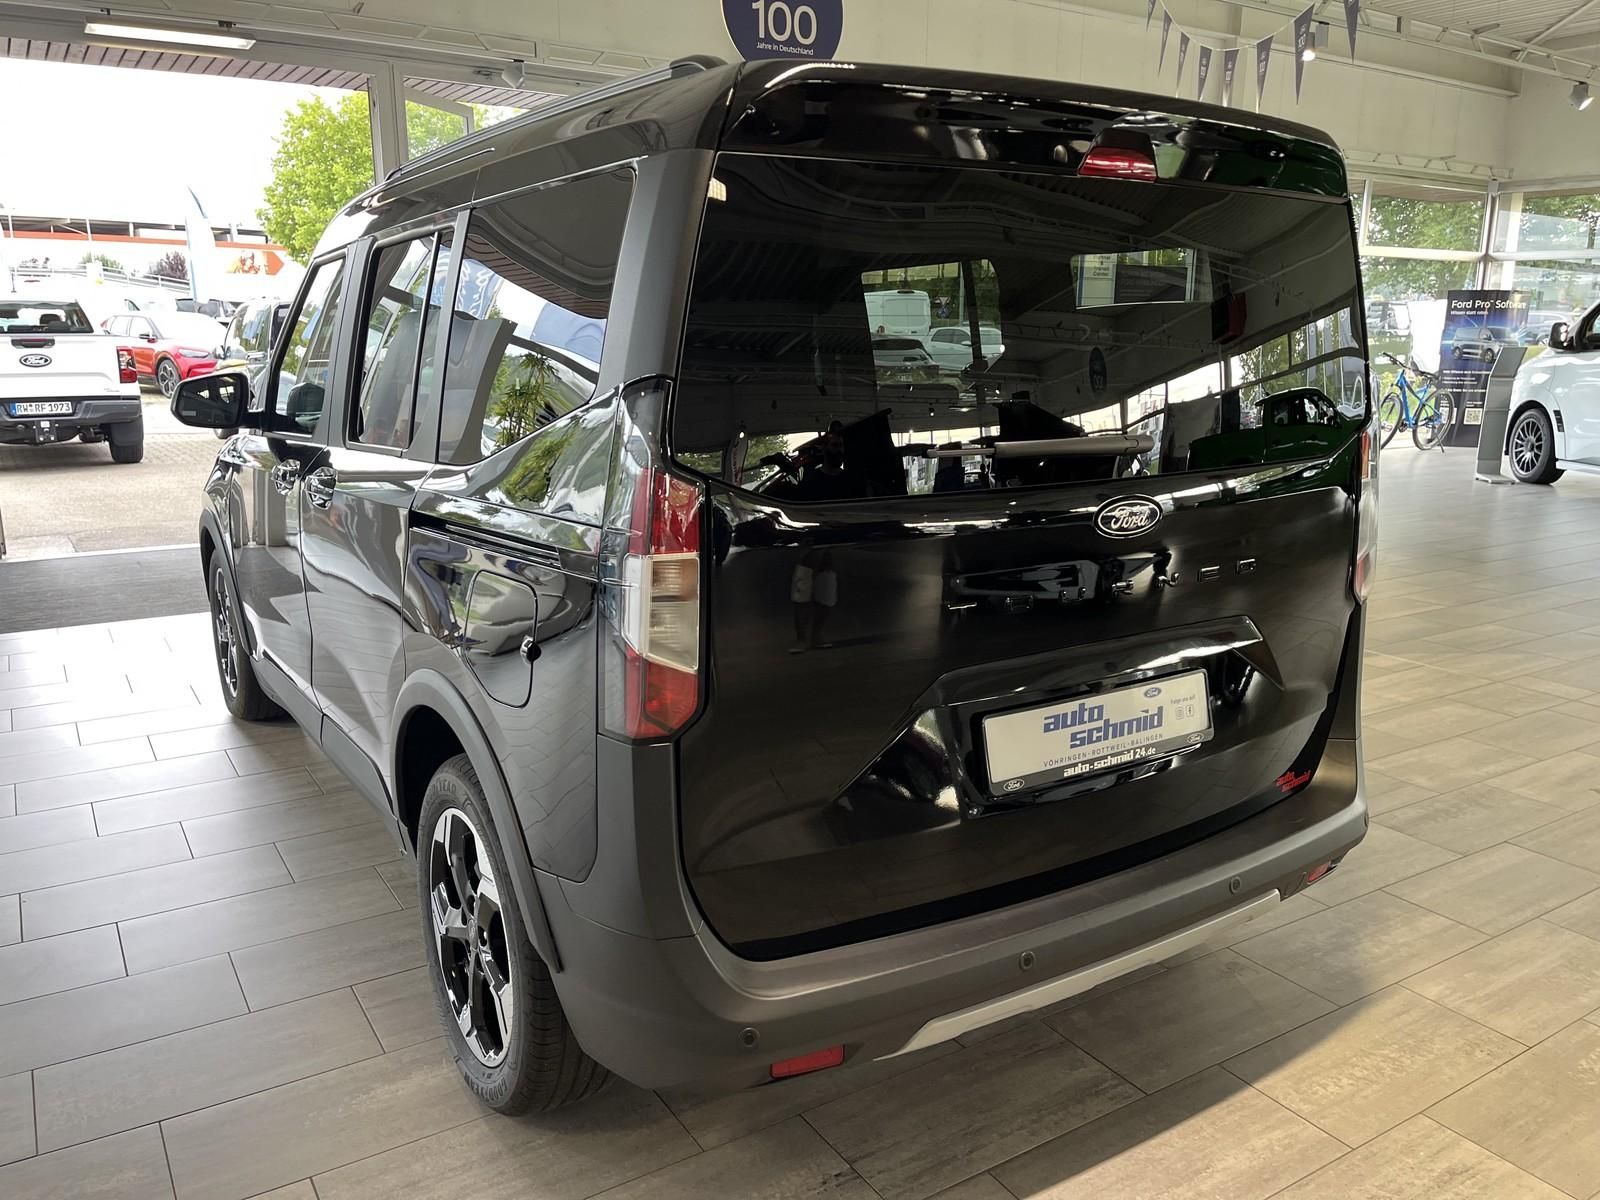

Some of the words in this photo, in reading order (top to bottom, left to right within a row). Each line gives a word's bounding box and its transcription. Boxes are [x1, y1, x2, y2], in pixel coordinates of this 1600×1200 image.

[752, 0, 817, 45] 100
[756, 42, 772, 50] Jahre
[772, 43, 779, 51] in
[779, 45, 813, 56] Deutschland
[1451, 300, 1472, 309] Ford
[16, 404, 29, 413] RW
[35, 403, 46, 412] RF
[49, 402, 71, 412] 1973
[1043, 702, 1104, 733] auto
[1070, 706, 1163, 749] schmid
